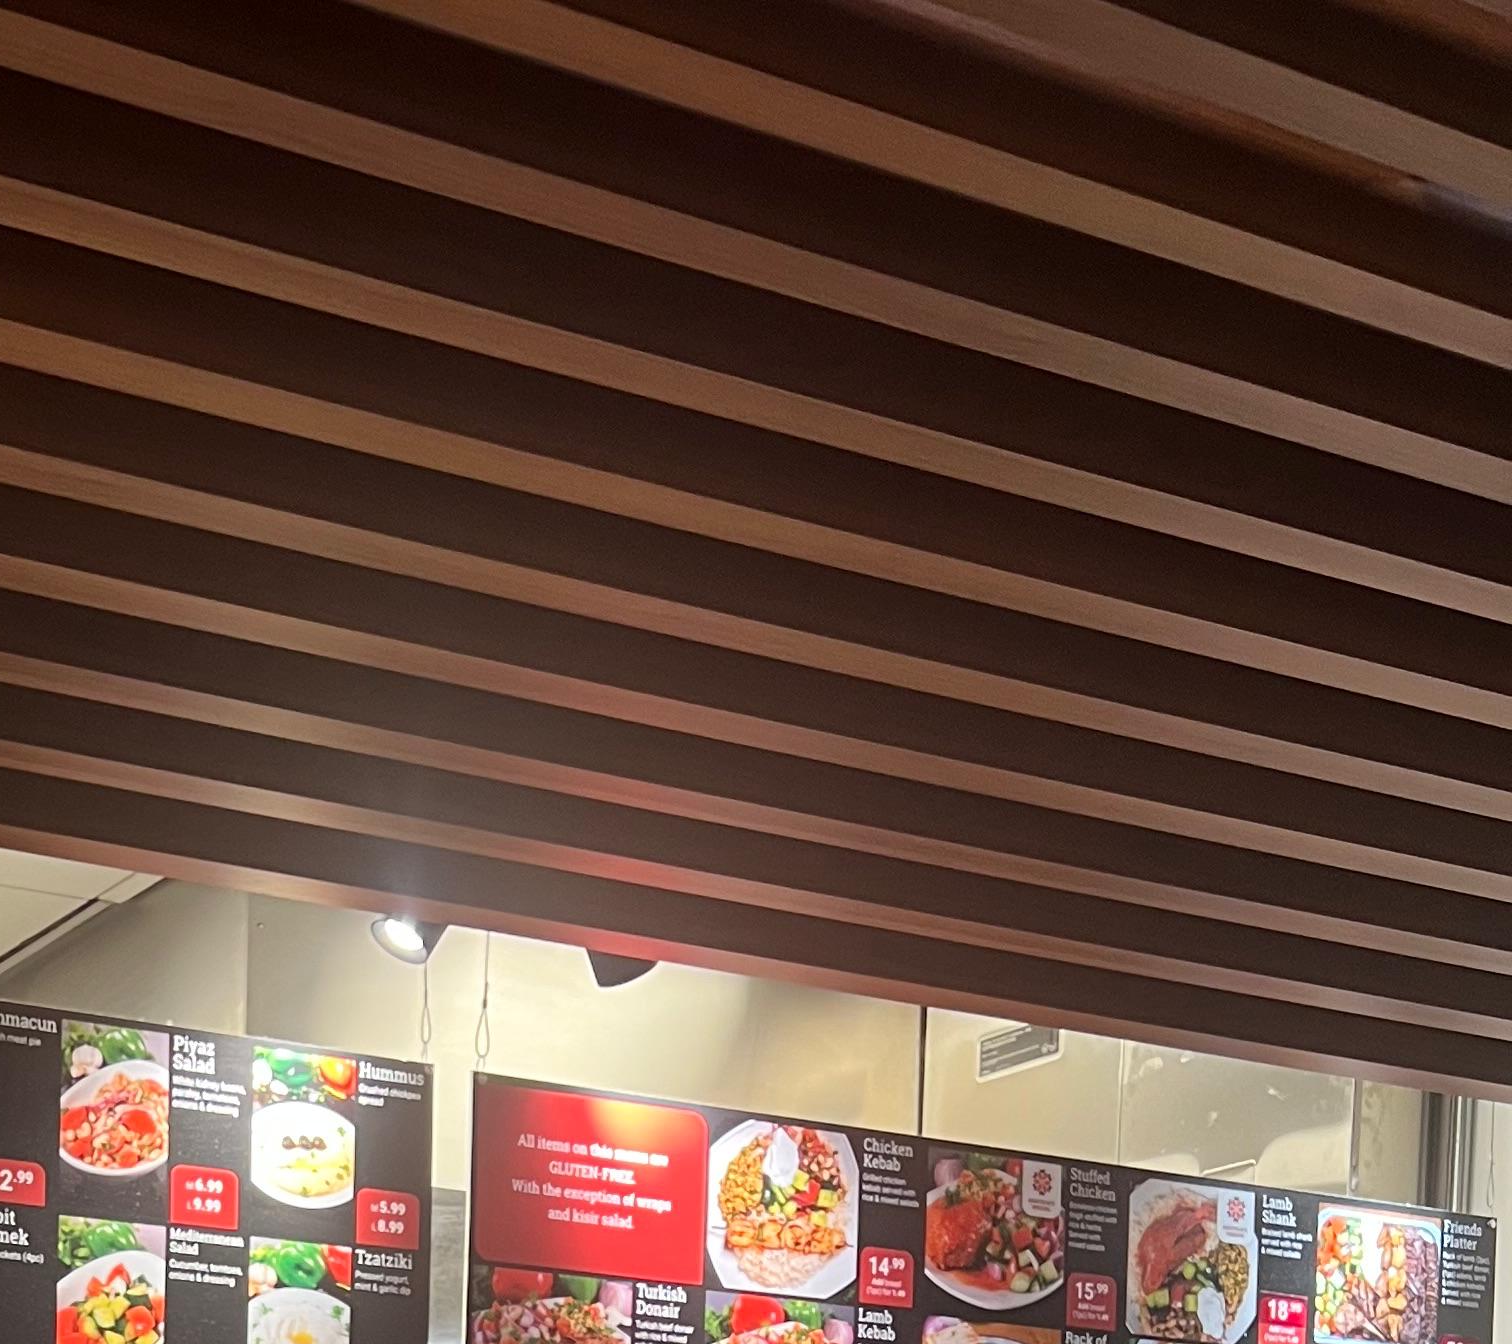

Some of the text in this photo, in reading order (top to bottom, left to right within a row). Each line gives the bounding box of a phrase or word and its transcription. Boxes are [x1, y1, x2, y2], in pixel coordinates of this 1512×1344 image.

[173, 1035, 215, 1057] Piyaz
[173, 1053, 215, 1074] Salad
[359, 1060, 425, 1086] Hummus
[517, 1134, 535, 1149] All
[537, 1137, 571, 1153] items
[572, 1143, 588, 1154] on
[589, 1143, 614, 1159] this
[864, 1138, 914, 1157] Chicken
[863, 1154, 901, 1171] Kebab
[1070, 1168, 1110, 1185] Stuffed
[195, 1178, 223, 1194] 6.99
[1070, 1183, 1116, 1201] Chicken
[512, 1178, 672, 1214] With the exception wraps
[1263, 1195, 1293, 1212] Lamb
[194, 1197, 221, 1213] 9.99
[379, 1200, 406, 1216] 5.99
[548, 1208, 570, 1221] and
[572, 1209, 600, 1223] kisir
[1262, 1210, 1296, 1227] Shank
[377, 1219, 404, 1234] 8.99
[1444, 1219, 1482, 1236] Friends
[169, 1241, 199, 1255] Salad
[1443, 1234, 1477, 1250] Platter
[354, 1248, 413, 1270] Tzatziki
[869, 1256, 905, 1276] 14.99
[636, 1283, 687, 1303] Turkish
[1076, 1282, 1109, 1300] 15.99
[636, 1299, 680, 1319] Donair
[858, 1308, 893, 1324] Lamb
[858, 1324, 896, 1341] Kebab
